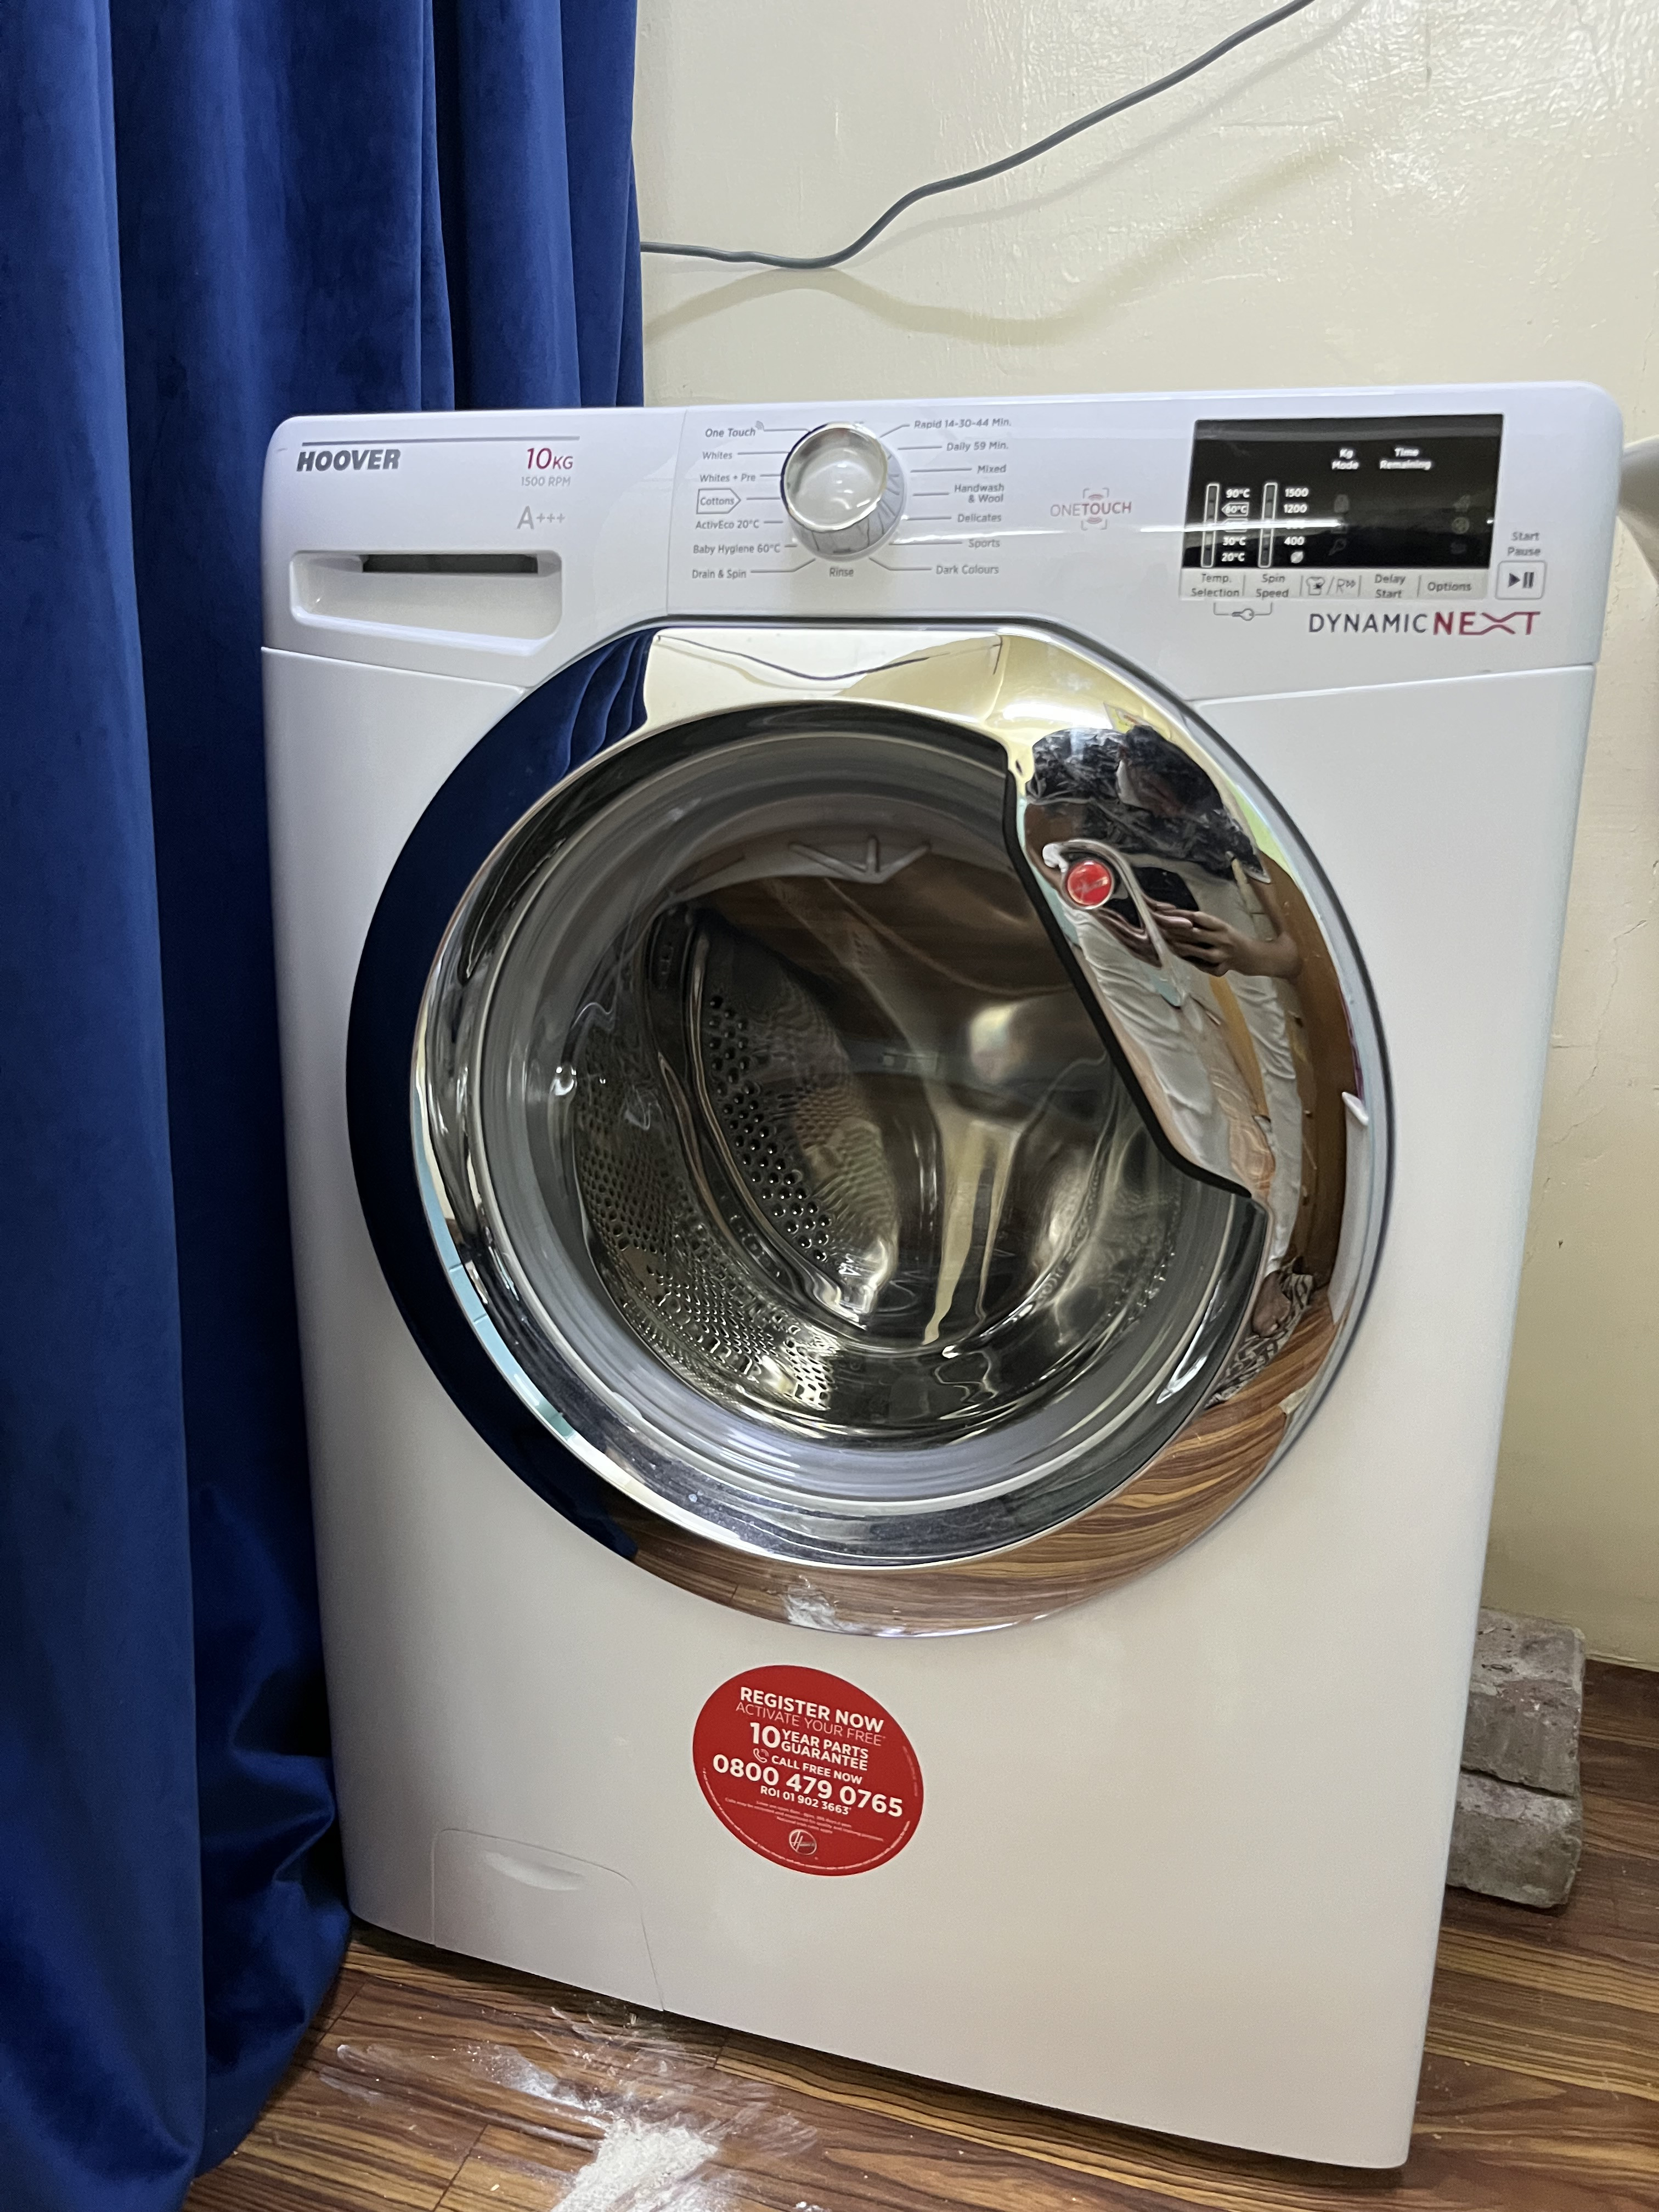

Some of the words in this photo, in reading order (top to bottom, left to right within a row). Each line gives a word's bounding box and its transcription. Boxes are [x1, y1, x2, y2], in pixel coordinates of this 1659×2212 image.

[914, 420, 942, 429] Rapid
[945, 418, 989, 428] 14-30-44
[992, 418, 1011, 427] Min.
[705, 428, 724, 437] One
[728, 428, 755, 437] Touch
[946, 442, 970, 452] Daily
[974, 441, 986, 450] 59
[989, 441, 1008, 450] Min.
[1395, 445, 1420, 457] Time
[703, 451, 732, 460] Whites
[1339, 447, 1354, 459] Kg
[296, 449, 401, 472] HOOVER
[977, 464, 1007, 474] Mixed
[521, 475, 545, 487] 1500
[548, 475, 571, 487] RPM
[699, 473, 730, 482] Whites
[741, 473, 755, 482] Pre
[955, 483, 1005, 493] Handwash
[1226, 488, 1250, 498] 90°C
[1285, 487, 1310, 498] 1500
[700, 497, 735, 506] Cottons
[968, 495, 975, 503] &
[979, 494, 1004, 503] Wool
[1283, 504, 1308, 514] 1200
[517, 505, 566, 529] A+++
[957, 512, 1002, 523] Delicates
[695, 521, 735, 529] ActivEco
[737, 520, 760, 528] 20°C
[1284, 536, 1305, 546] 400
[1511, 531, 1540, 541] Start
[693, 545, 715, 555] Baby
[718, 544, 754, 555] Hygiene
[757, 543, 781, 553] 60°C
[968, 539, 1000, 549] Sports
[1222, 552, 1245, 562] 20°C
[1507, 546, 1541, 557] Pause
[692, 569, 715, 579] Drain
[727, 569, 747, 579] Spin
[829, 566, 854, 577] Rinse
[936, 564, 958, 574] Dark
[962, 564, 1000, 574] Colours
[1200, 573, 1232, 584] Temp.
[1262, 573, 1285, 584] Spin
[1374, 574, 1406, 586] Delay
[1427, 580, 1472, 592] Options
[1191, 588, 1240, 597] Selection
[1255, 588, 1289, 600] Speed
[1375, 589, 1402, 599] Start
[741, 1686, 830, 1721] REGISTER
[836, 1709, 884, 1733] NOW
[736, 1702, 800, 1727] ACTIVATE
[804, 1717, 843, 1737] YOUR
[750, 1722, 781, 1748] 10
[782, 1729, 820, 1748] YEAR
[823, 1739, 868, 1760] PARTS
[781, 1741, 868, 1771] GUARANTEE
[771, 1755, 800, 1770] CALL
[803, 1763, 831, 1778] FREE
[833, 1770, 862, 1785] NOW
[713, 1754, 779, 1786] 0800
[786, 1773, 832, 1799] 479
[839, 1785, 902, 1817] 0765
[760, 1785, 780, 1798] ROI
[783, 1791, 795, 1802] 01
[797, 1795, 819, 1808] 902
